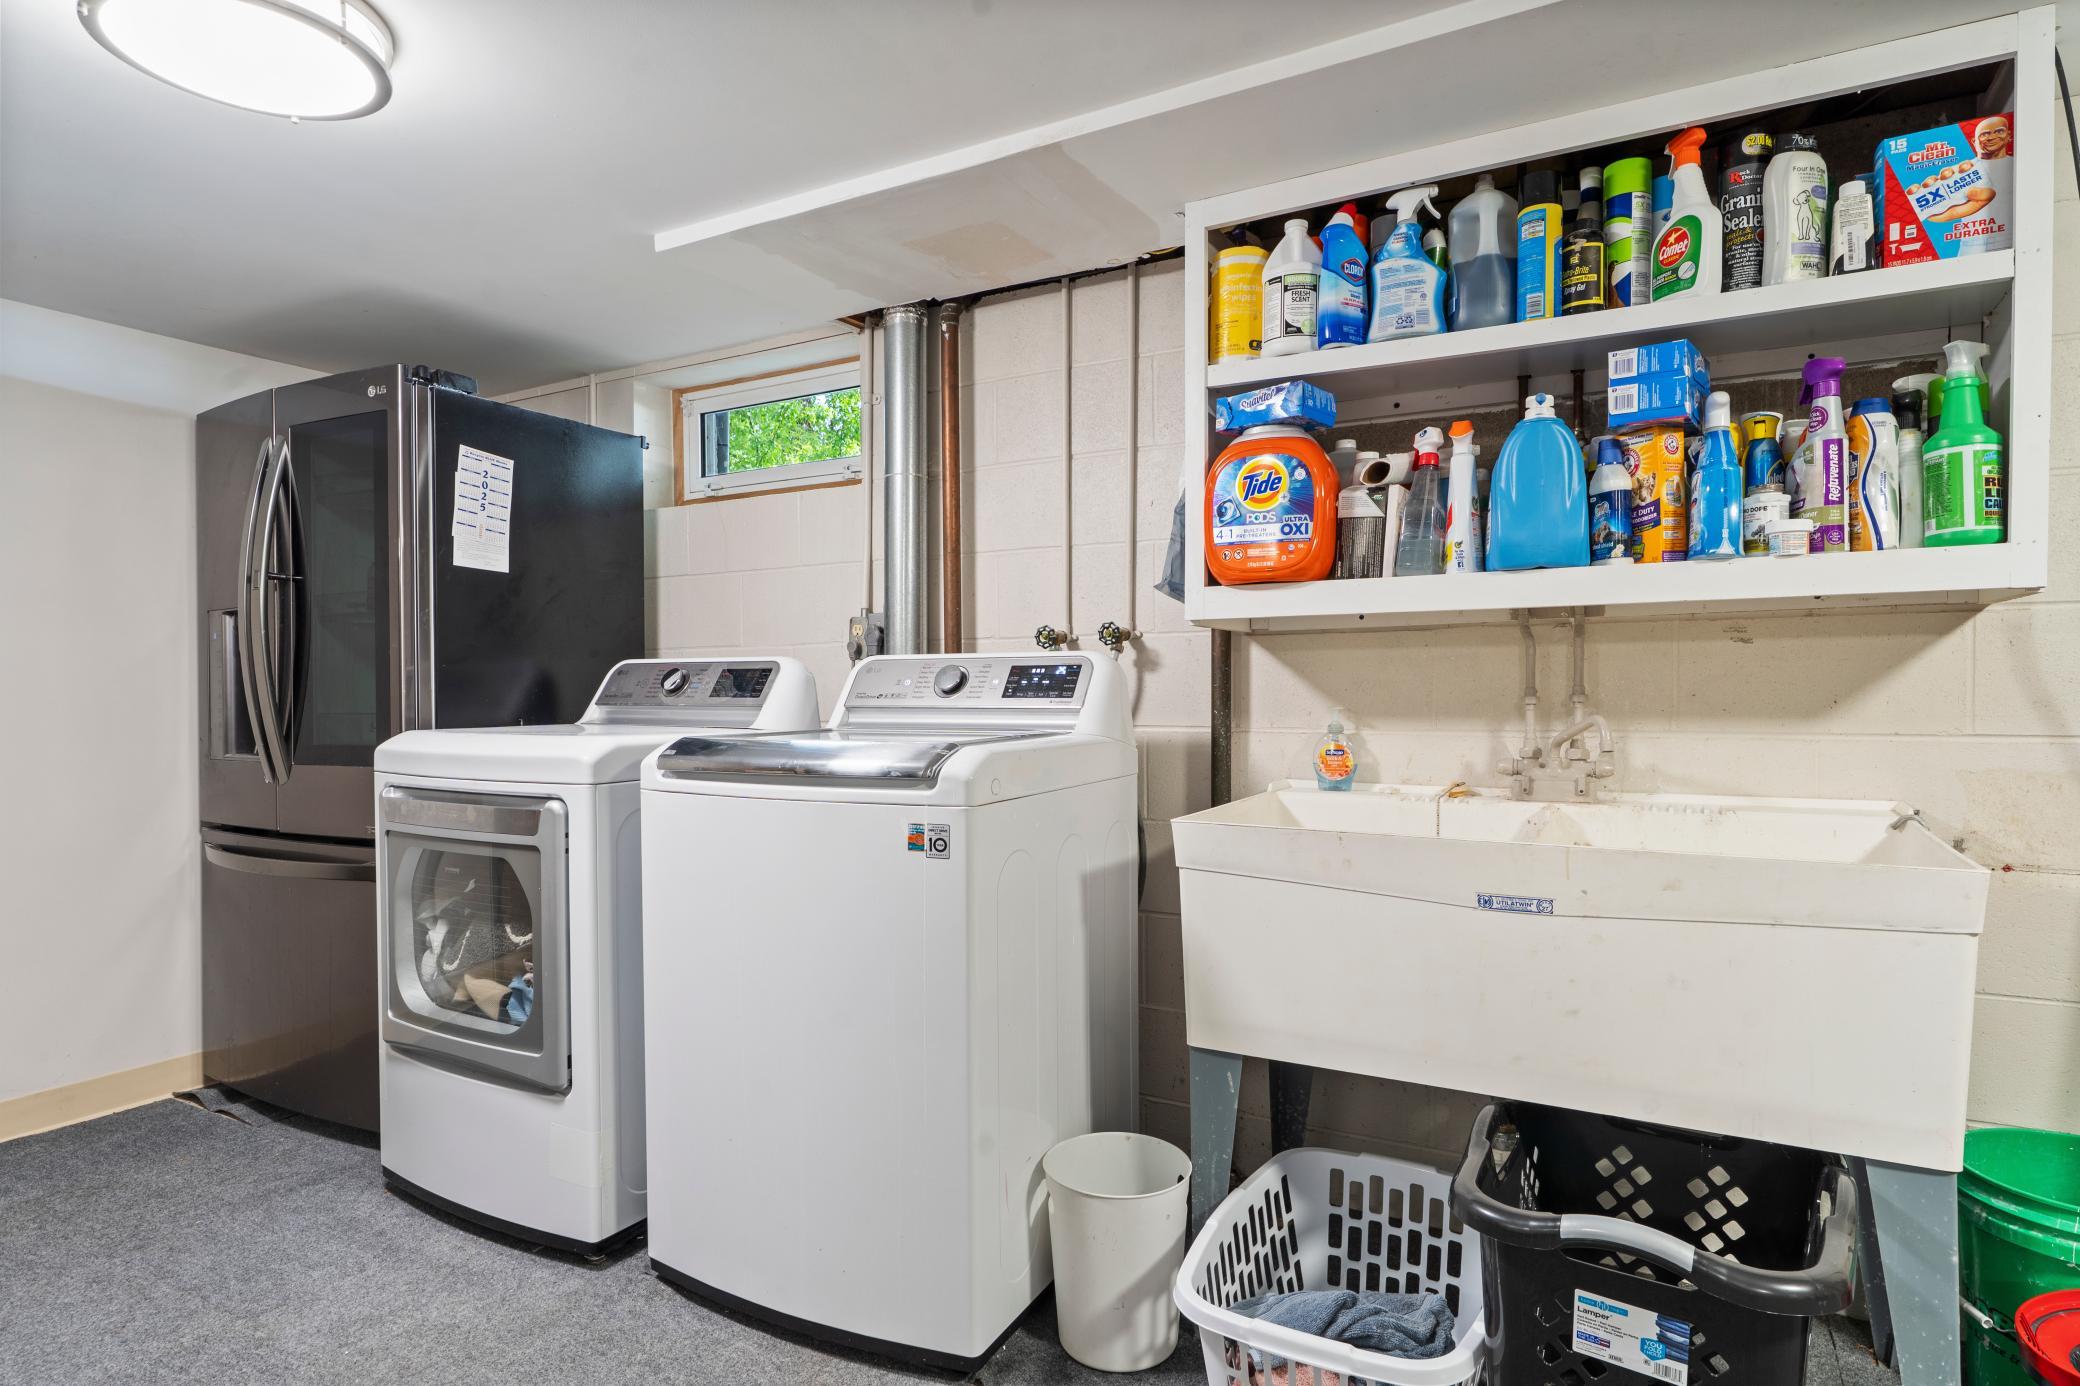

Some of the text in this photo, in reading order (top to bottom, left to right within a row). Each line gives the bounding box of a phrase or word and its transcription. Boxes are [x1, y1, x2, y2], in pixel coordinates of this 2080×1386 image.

[1889, 138, 1907, 150] 15
[1925, 141, 1949, 152] Mr.
[1908, 147, 1956, 164] Clean
[1946, 169, 1980, 190] LASTS
[1949, 175, 1983, 195] LONGER
[1720, 186, 1762, 214] Grani
[1915, 187, 1945, 209] 5X
[1920, 197, 1947, 213] STRONGER
[1953, 218, 1997, 231] EXTRA
[1944, 224, 2006, 242] DURABLE
[1660, 239, 1688, 261] Comet
[1344, 264, 1364, 277] CLOROX
[376, 385, 387, 394] LG
[1240, 388, 1275, 409] Suavitel
[1828, 443, 1839, 501] Rejuvenate
[1242, 469, 1283, 502] Tide
[1638, 505, 1655, 516] DUTY
[1749, 505, 1768, 514] DOPE
[1246, 512, 1276, 524] PODS
[1284, 515, 1309, 523] ULTRA
[1216, 529, 1223, 540] 4
[1280, 522, 1309, 536] OXI
[928, 837, 947, 853] 10
[1577, 1305, 1610, 1321] Lamper
[1645, 1340, 1663, 1350] YOU
